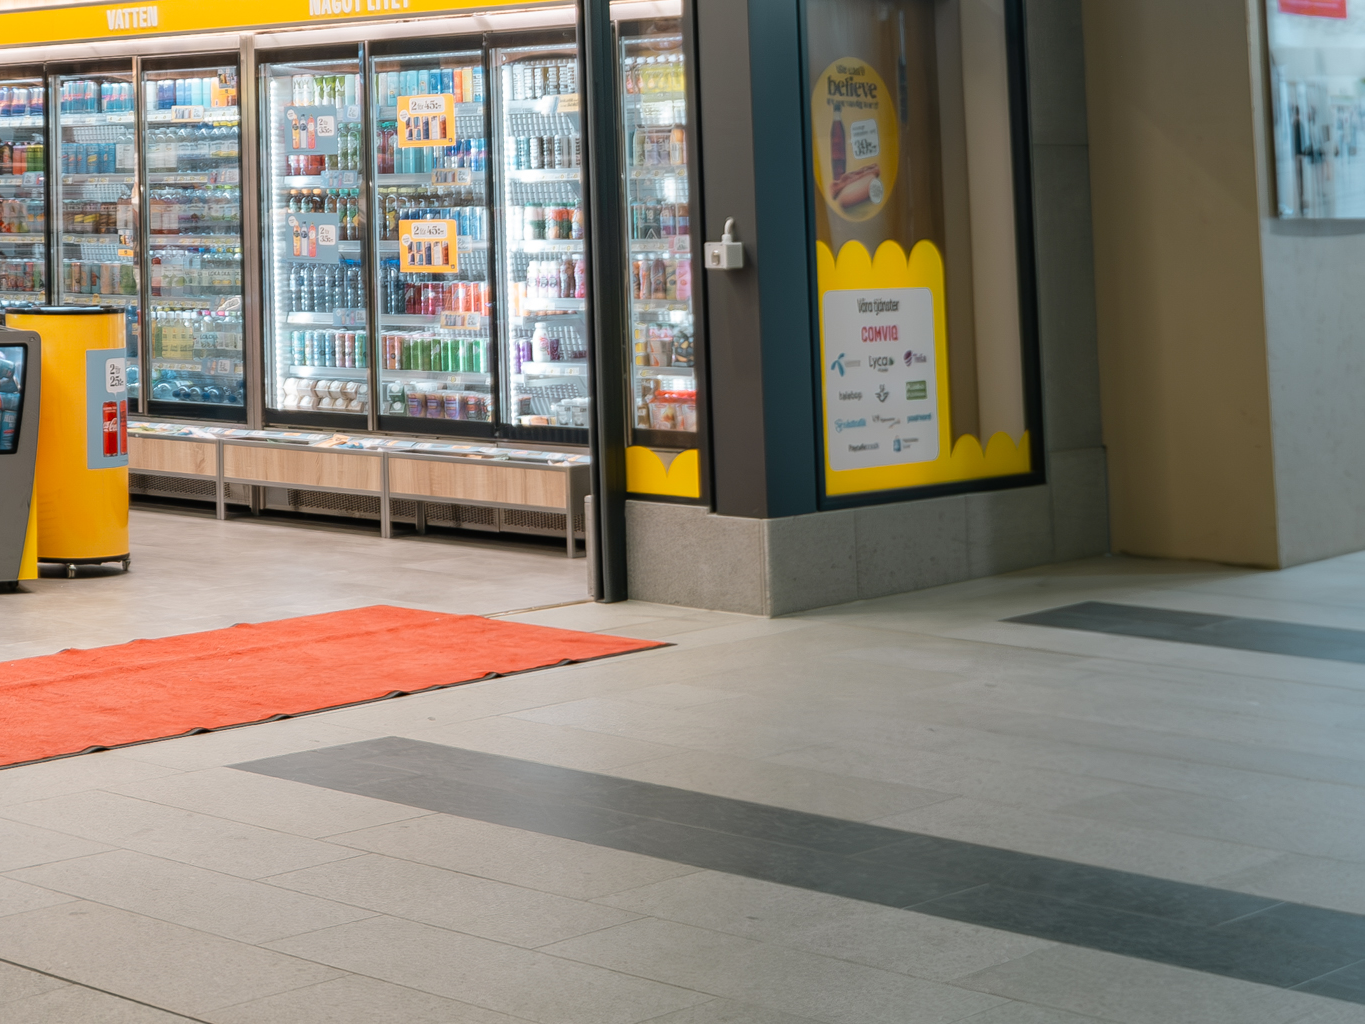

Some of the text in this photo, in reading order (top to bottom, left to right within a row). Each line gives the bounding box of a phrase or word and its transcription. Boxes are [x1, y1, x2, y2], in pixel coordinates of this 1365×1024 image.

[106, 5, 159, 31] VATTEN
[827, 75, 878, 99] believe
[411, 101, 417, 110] 2
[318, 118, 324, 126] 2
[320, 227, 325, 235] 2
[413, 225, 419, 235] 2
[856, 298, 873, 314] Våra
[861, 325, 899, 343] COMVIQ
[109, 363, 115, 375] 2
